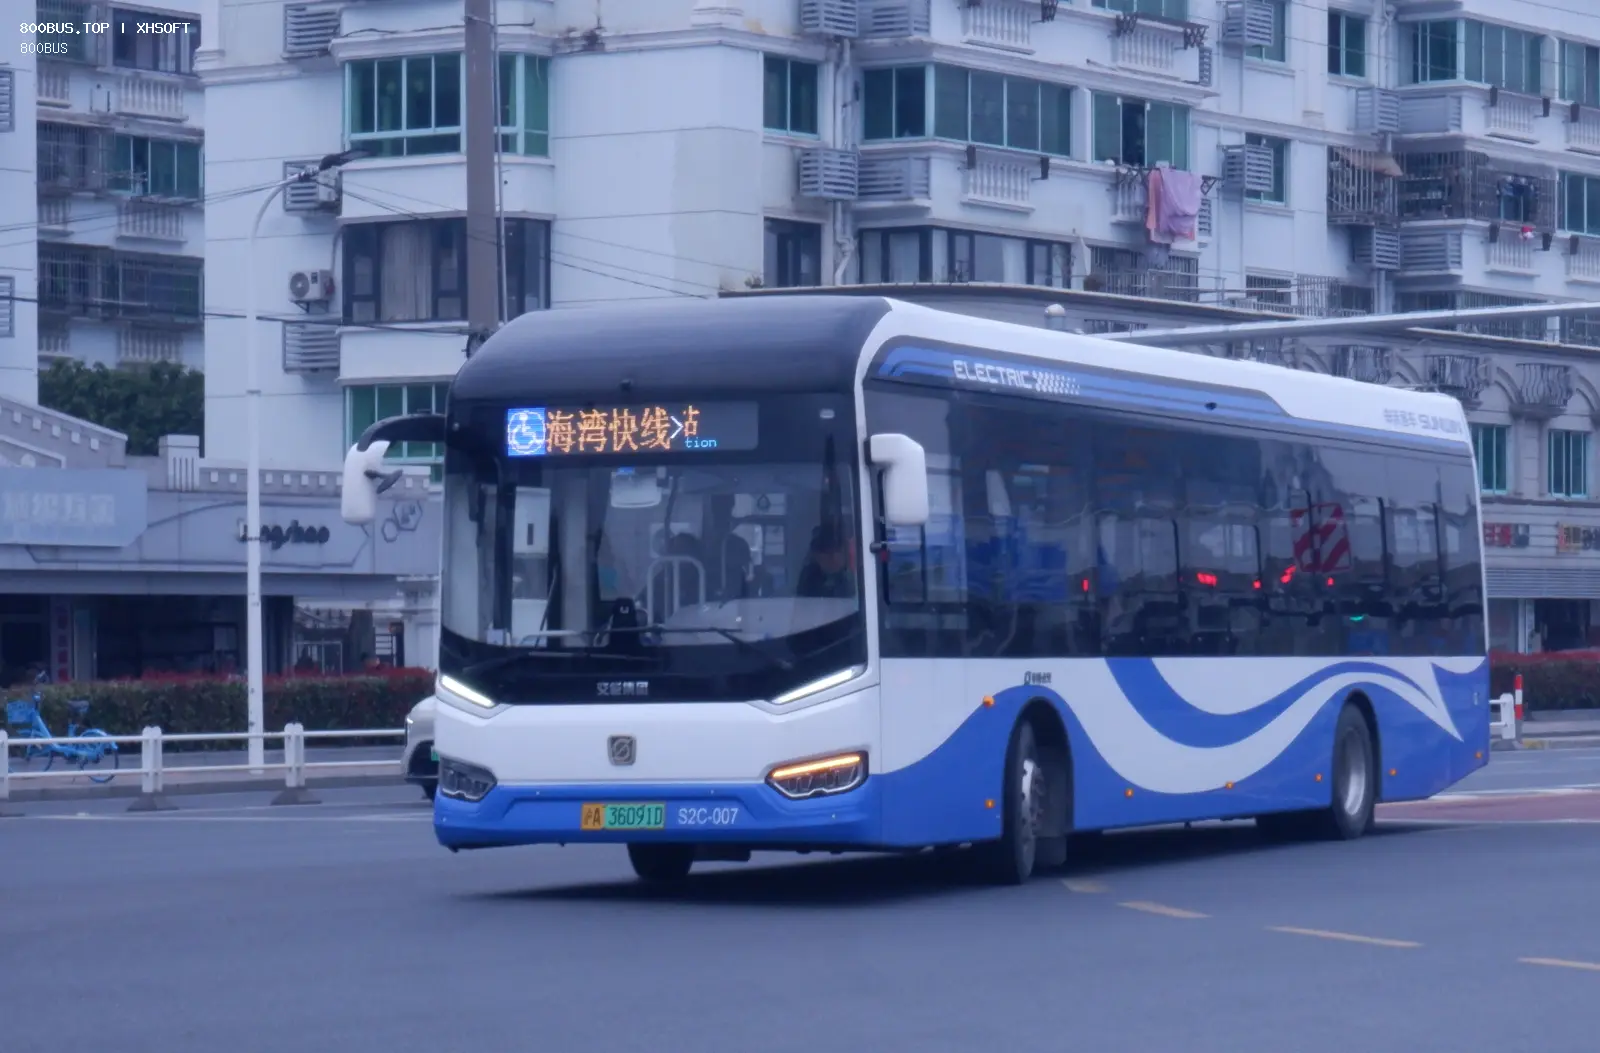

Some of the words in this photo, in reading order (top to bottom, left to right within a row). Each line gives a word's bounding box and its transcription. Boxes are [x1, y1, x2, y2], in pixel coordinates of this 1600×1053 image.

[953, 359, 1033, 389] ELECTRIC
[546, 406, 671, 453] 海湾快线
[684, 437, 718, 448] tion
[608, 806, 664, 826] 36091D
[678, 807, 739, 825] S2C-007
